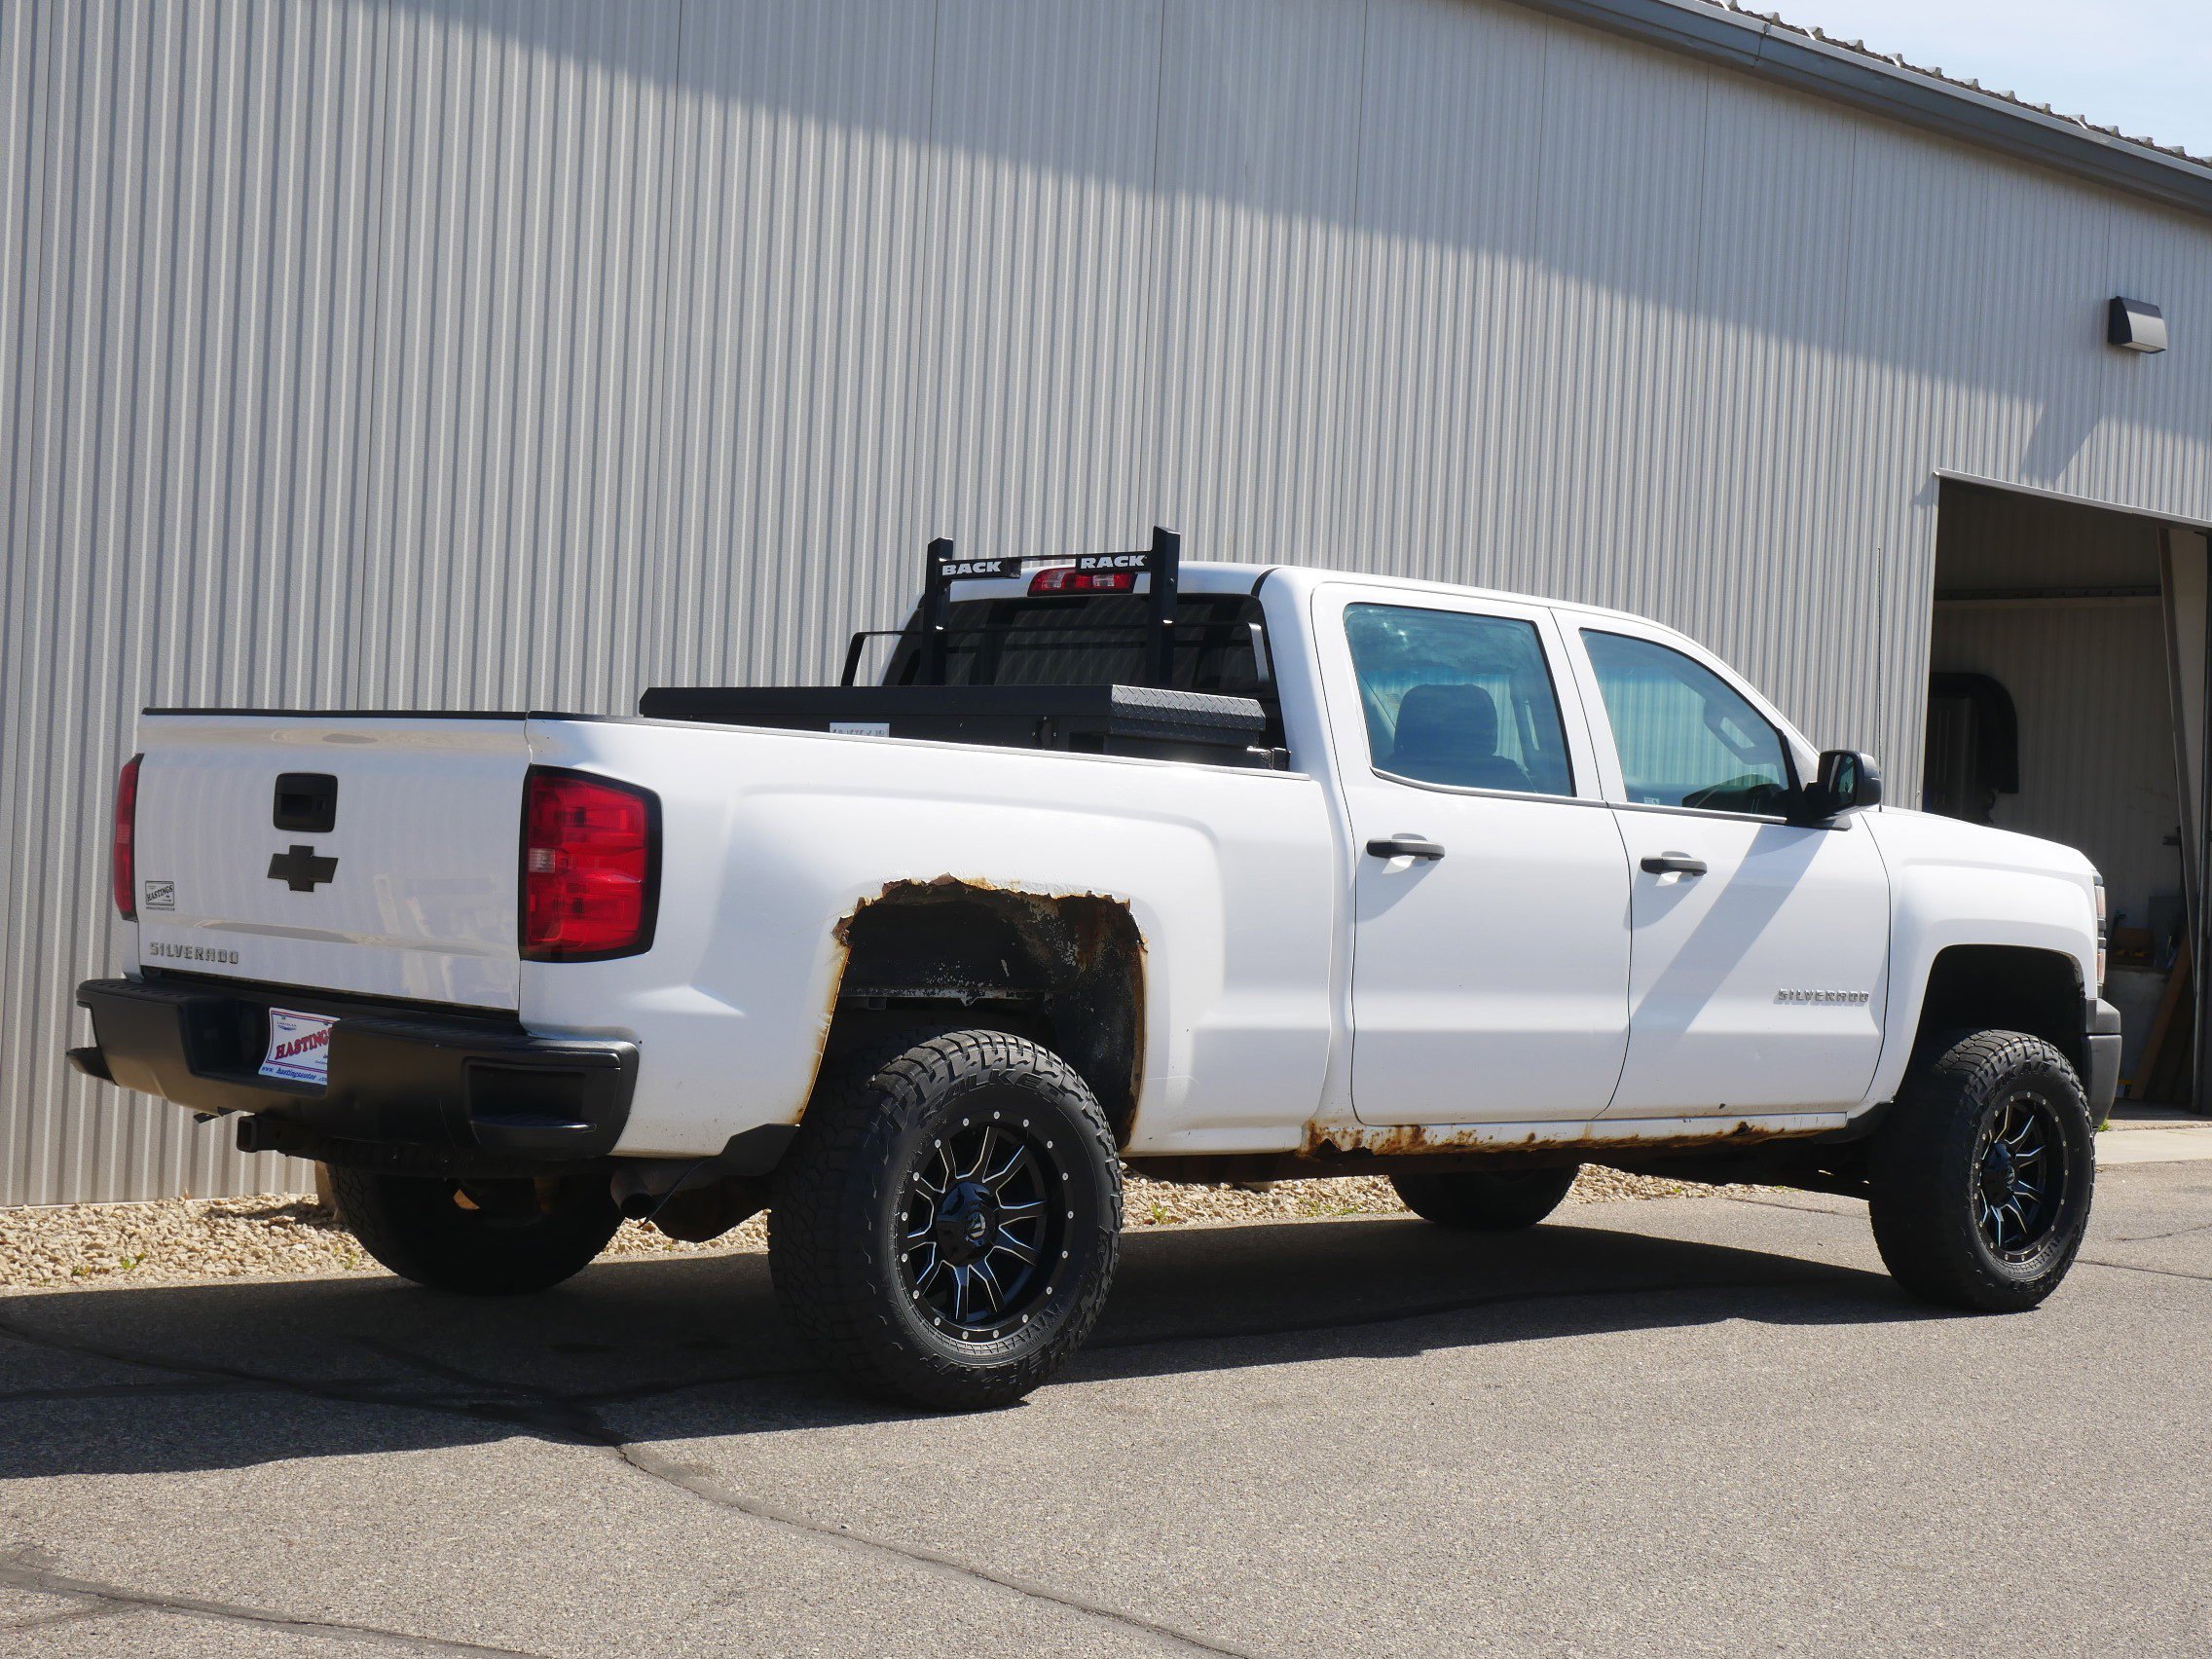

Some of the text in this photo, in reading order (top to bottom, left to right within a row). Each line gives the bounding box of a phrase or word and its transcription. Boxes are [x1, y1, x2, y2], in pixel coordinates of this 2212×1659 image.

[941, 554, 1146, 576] BACK RACK
[146, 884, 173, 903] HASTINGS
[150, 941, 240, 965] SILVERADO
[1778, 987, 1869, 1003] SILVERADO
